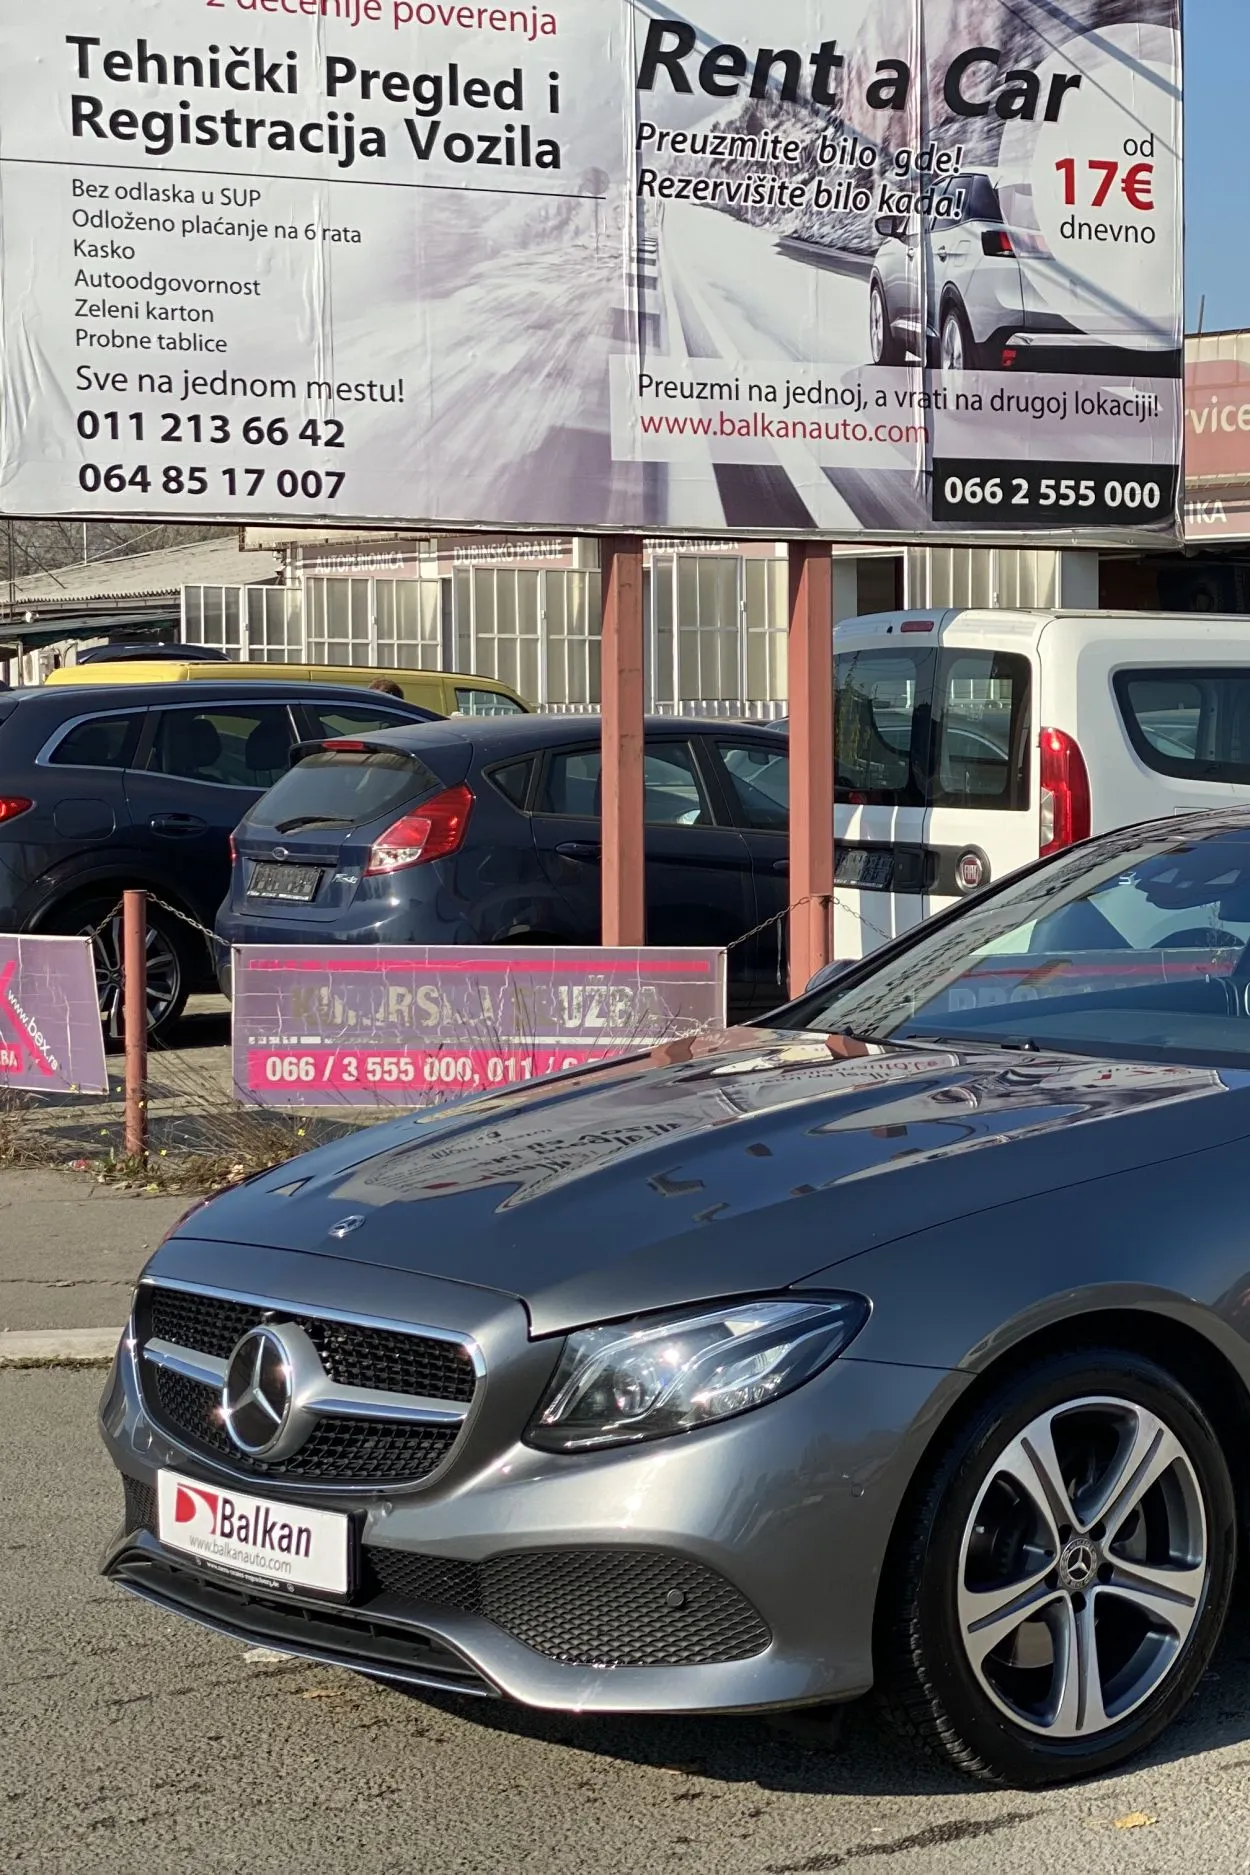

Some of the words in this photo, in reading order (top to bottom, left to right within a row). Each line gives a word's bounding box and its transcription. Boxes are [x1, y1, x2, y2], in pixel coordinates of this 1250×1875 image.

[394, 1, 557, 41] poverenja
[66, 35, 298, 95] Tehnički
[325, 56, 524, 117] Pregled
[548, 71, 561, 114] i
[635, 18, 843, 104] Rent
[866, 68, 912, 111] a
[943, 46, 1082, 122] Car
[71, 95, 387, 169] Registracija
[404, 118, 562, 170] Vozila
[635, 122, 801, 164] Preuzmite
[818, 131, 877, 169] bilo
[894, 144, 964, 176] gde!
[1122, 133, 1155, 158] od
[72, 179, 110, 200] Bez
[115, 180, 195, 204] odlaska
[202, 190, 214, 205] u
[220, 187, 262, 208] SUP
[637, 168, 806, 208] Rezervišite
[813, 178, 871, 214] bilo
[877, 184, 965, 219] kada!
[1054, 158, 1155, 210] 17€
[71, 208, 175, 233] Odloženo
[181, 215, 269, 241] plaćanje
[275, 224, 299, 240] na
[304, 223, 317, 242] 6
[322, 226, 362, 244] rata
[1059, 215, 1156, 244] dnevno
[73, 239, 136, 261] Kasko
[74, 269, 261, 297] Autoodgovornost
[75, 298, 140, 321] Zeleni
[146, 302, 214, 323] karton
[75, 328, 152, 350] Probne
[158, 331, 228, 353] tablice
[76, 364, 128, 392] Sve
[138, 373, 173, 394] na
[180, 369, 297, 400] jednom
[307, 377, 405, 403] mestu!
[638, 373, 740, 402] Preuzmi
[748, 383, 778, 402] na
[782, 378, 868, 412] jednoj,
[874, 391, 888, 408] a
[894, 390, 948, 411] vrati
[954, 392, 984, 411] na
[990, 389, 1068, 417] drugoj
[1074, 393, 1160, 420] lokaciji!
[77, 410, 146, 441] 011
[161, 412, 230, 443] 213
[242, 416, 289, 446] 66
[299, 418, 346, 448] 42
[640, 411, 930, 445] www.balkanauto.com
[78, 463, 151, 493] 064
[162, 465, 208, 495] 85
[222, 467, 265, 497] 17
[276, 469, 346, 499] 007
[944, 477, 1003, 504] 066
[1011, 478, 1030, 505] 2
[1038, 480, 1095, 506] 555
[1104, 481, 1161, 508] 000
[315, 552, 405, 574] AUTOPERIONICA
[453, 546, 515, 566] DUBINSKO
[516, 540, 564, 561] PRANJE
[265, 1056, 315, 1081] 066
[323, 1055, 333, 1081] /
[342, 1056, 356, 1081] 3
[366, 1056, 415, 1082] 555
[424, 1057, 481, 1087] 000,
[220, 1496, 312, 1559] Balkan
[189, 1534, 292, 1575] www.balkanauto.com
